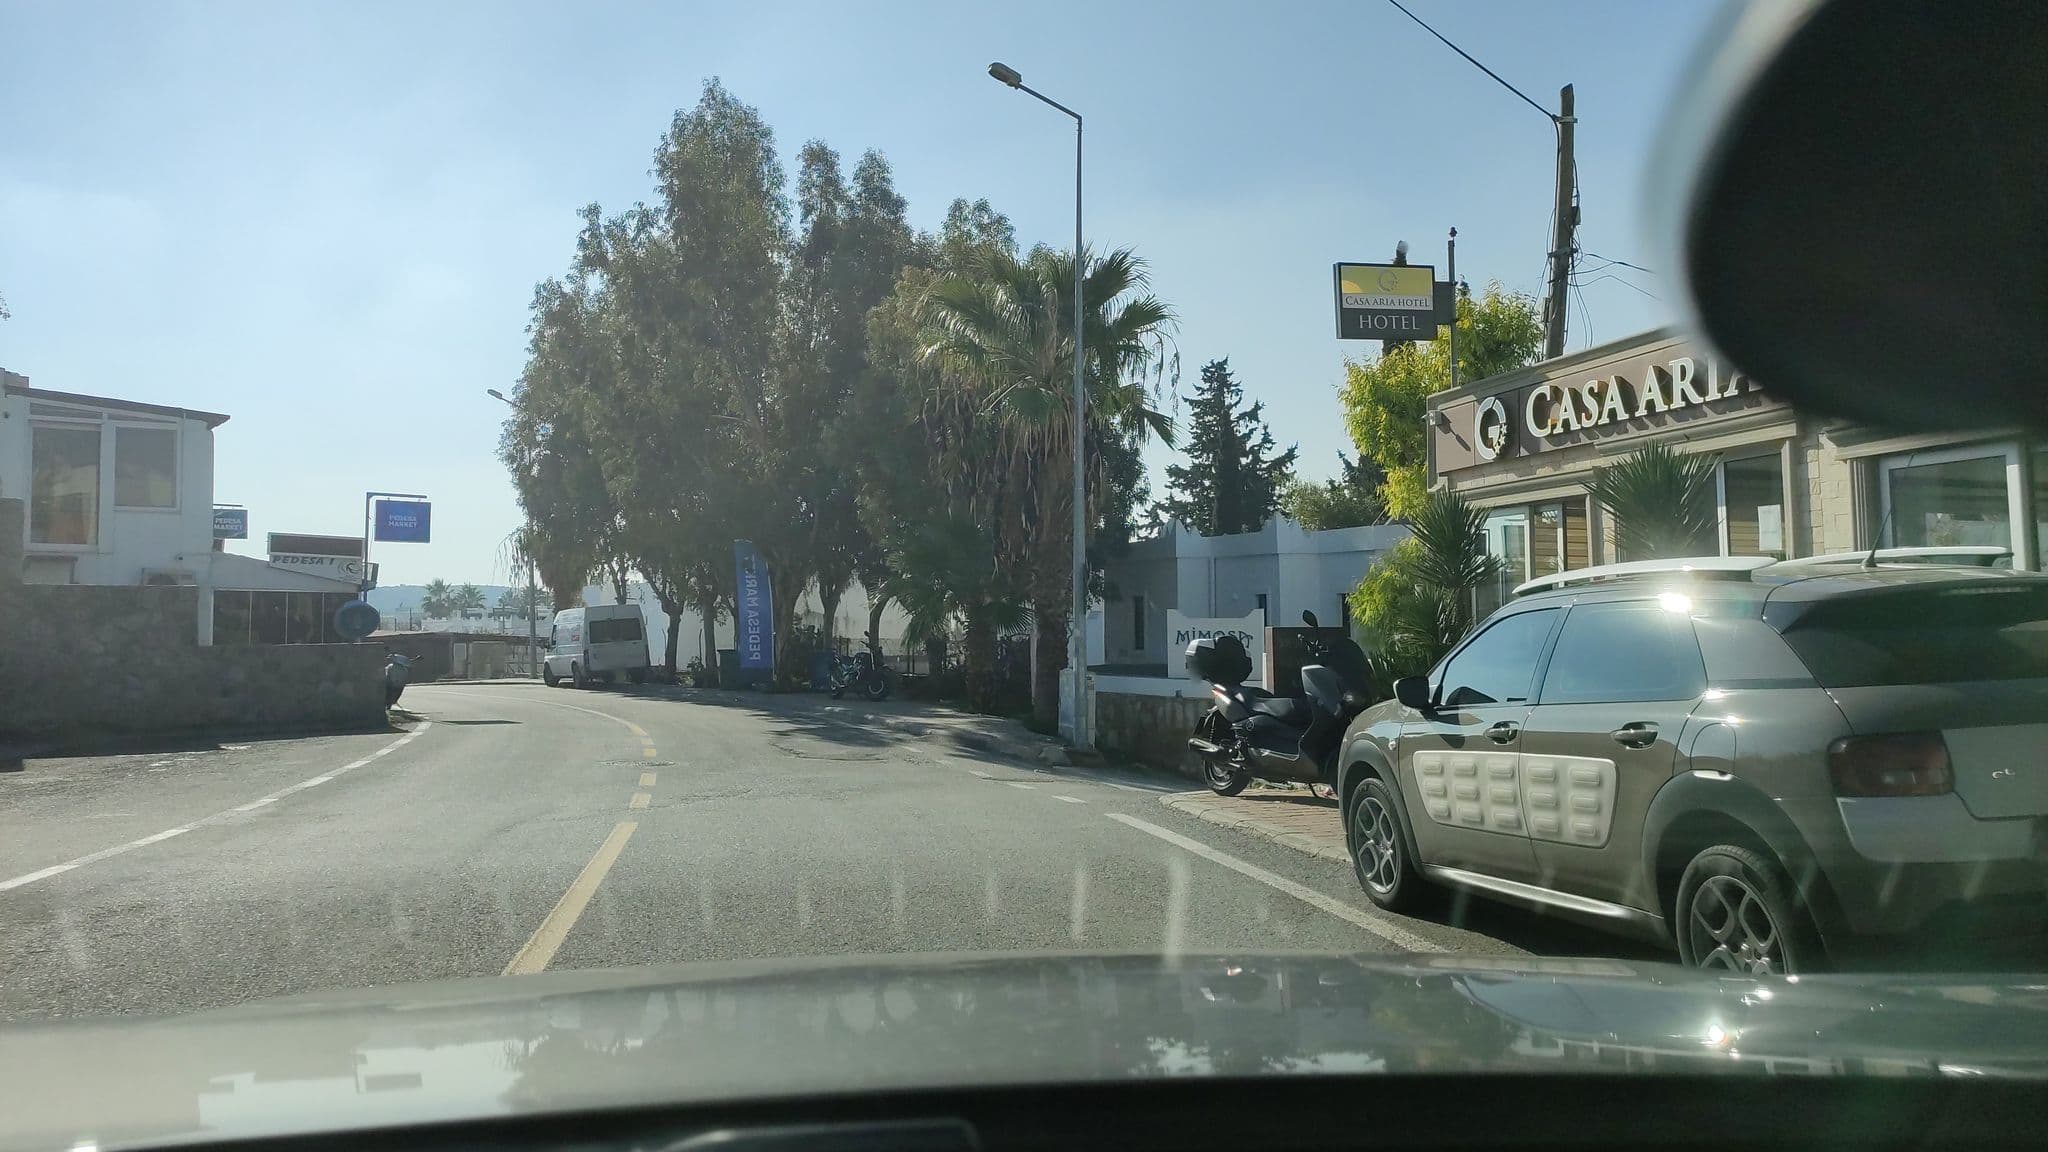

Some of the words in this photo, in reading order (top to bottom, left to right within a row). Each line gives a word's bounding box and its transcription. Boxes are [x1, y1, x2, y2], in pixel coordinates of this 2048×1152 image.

[1345, 296, 1370, 306] CASA
[1371, 297, 1396, 306] ARIA
[1398, 298, 1430, 307] HOTEL
[1359, 314, 1421, 330] HOTEL
[1525, 375, 1630, 439] CASA
[272, 555, 324, 565] PEDESA
